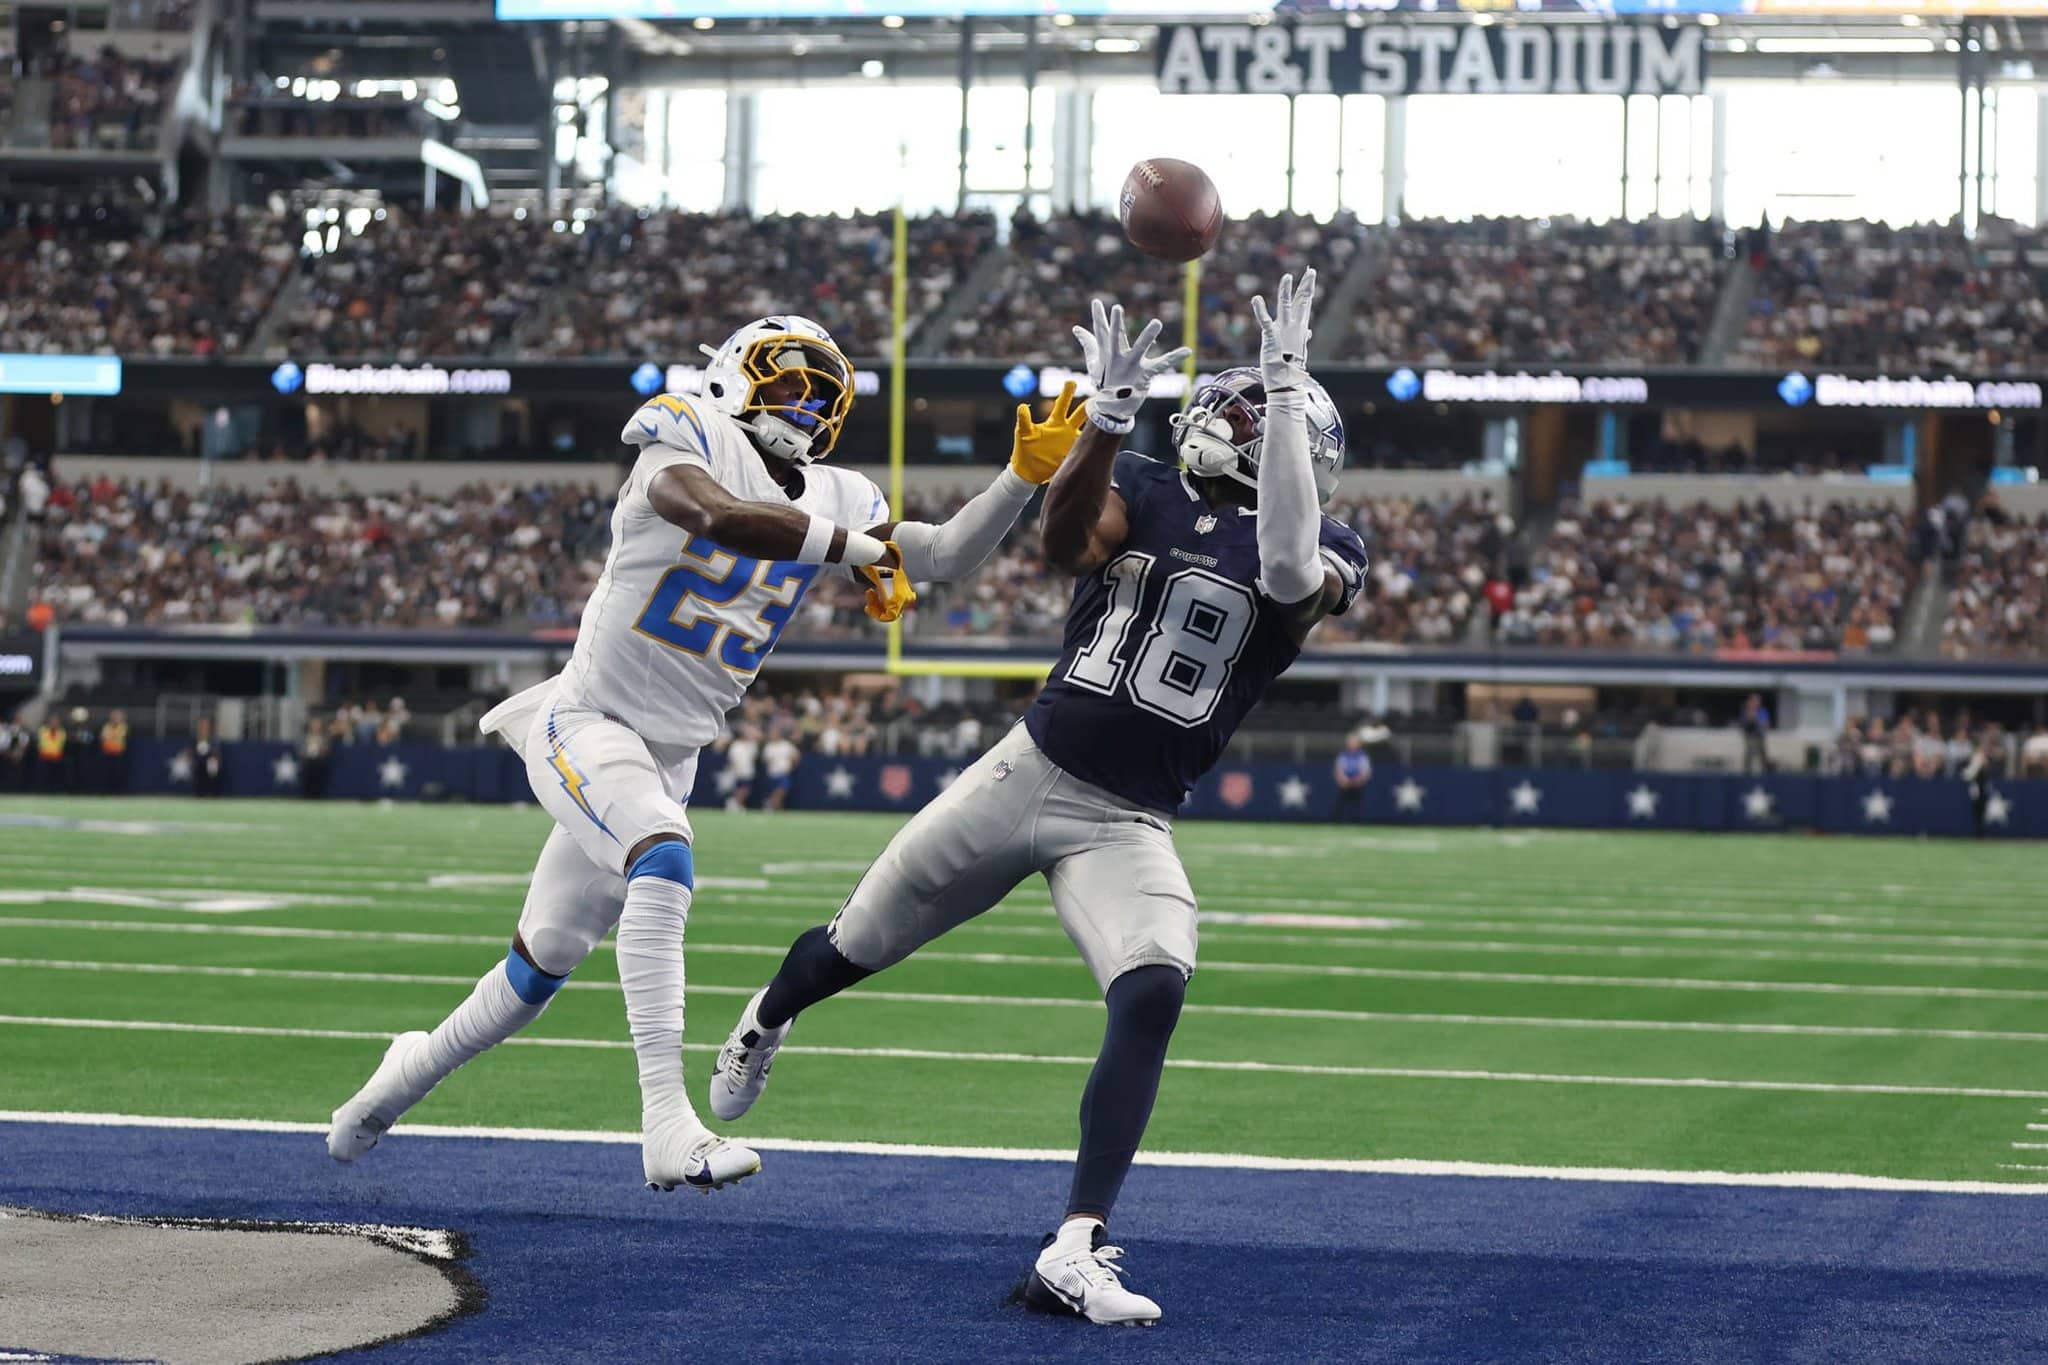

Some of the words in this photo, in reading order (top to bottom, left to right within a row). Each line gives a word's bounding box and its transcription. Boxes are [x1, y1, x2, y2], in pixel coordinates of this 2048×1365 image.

[1160, 25, 1346, 94] AT&T
[1361, 25, 1702, 95] STADIUM
[631, 535, 819, 675] 23
[1063, 550, 1258, 728] 18
